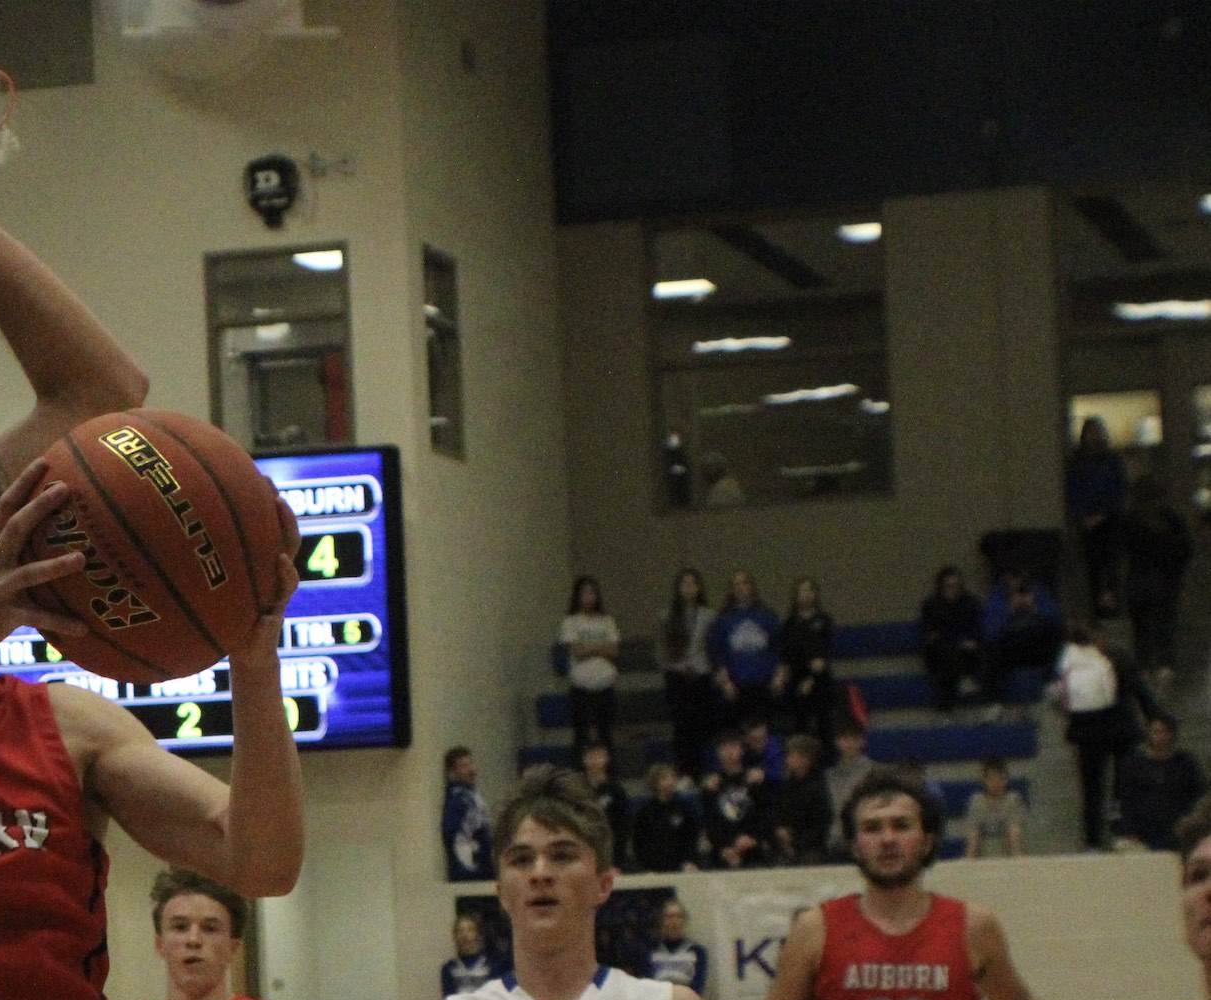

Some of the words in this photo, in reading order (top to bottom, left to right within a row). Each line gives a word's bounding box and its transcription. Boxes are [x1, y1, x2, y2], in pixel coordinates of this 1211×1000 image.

[105, 428, 159, 468] PRO
[280, 484, 365, 516] BURN
[143, 461, 229, 591] ELITE
[307, 534, 340, 577] 4
[296, 621, 336, 648] TOL
[176, 701, 203, 739] 2
[844, 962, 949, 991] AUBURN
